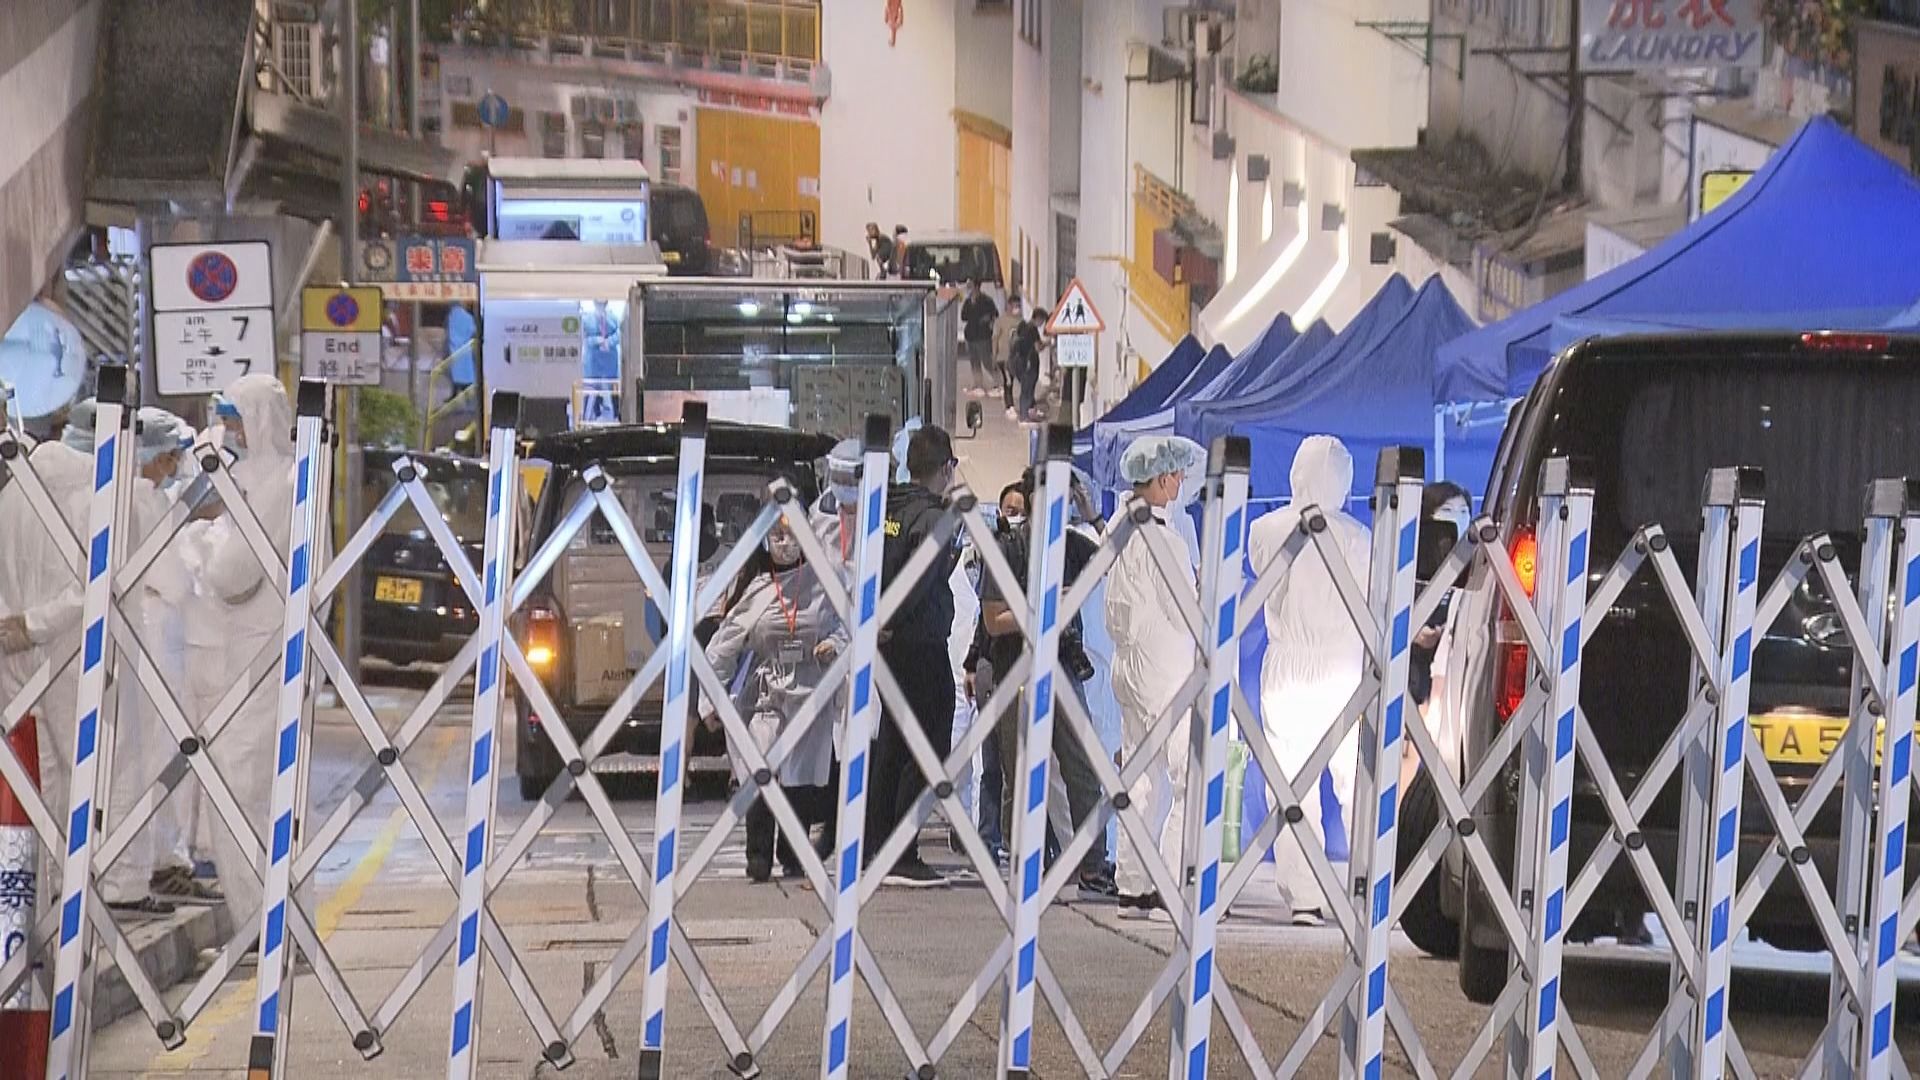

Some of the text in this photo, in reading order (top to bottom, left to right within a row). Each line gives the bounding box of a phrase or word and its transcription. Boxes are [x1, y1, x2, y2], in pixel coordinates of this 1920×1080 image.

[1588, 31, 1760, 64] LAUNDRY
[178, 327, 213, 344] 上午
[185, 316, 249, 341] am 7
[325, 338, 360, 353] End
[186, 358, 208, 370] pm
[318, 359, 366, 380] 終止
[180, 371, 217, 388] 下午
